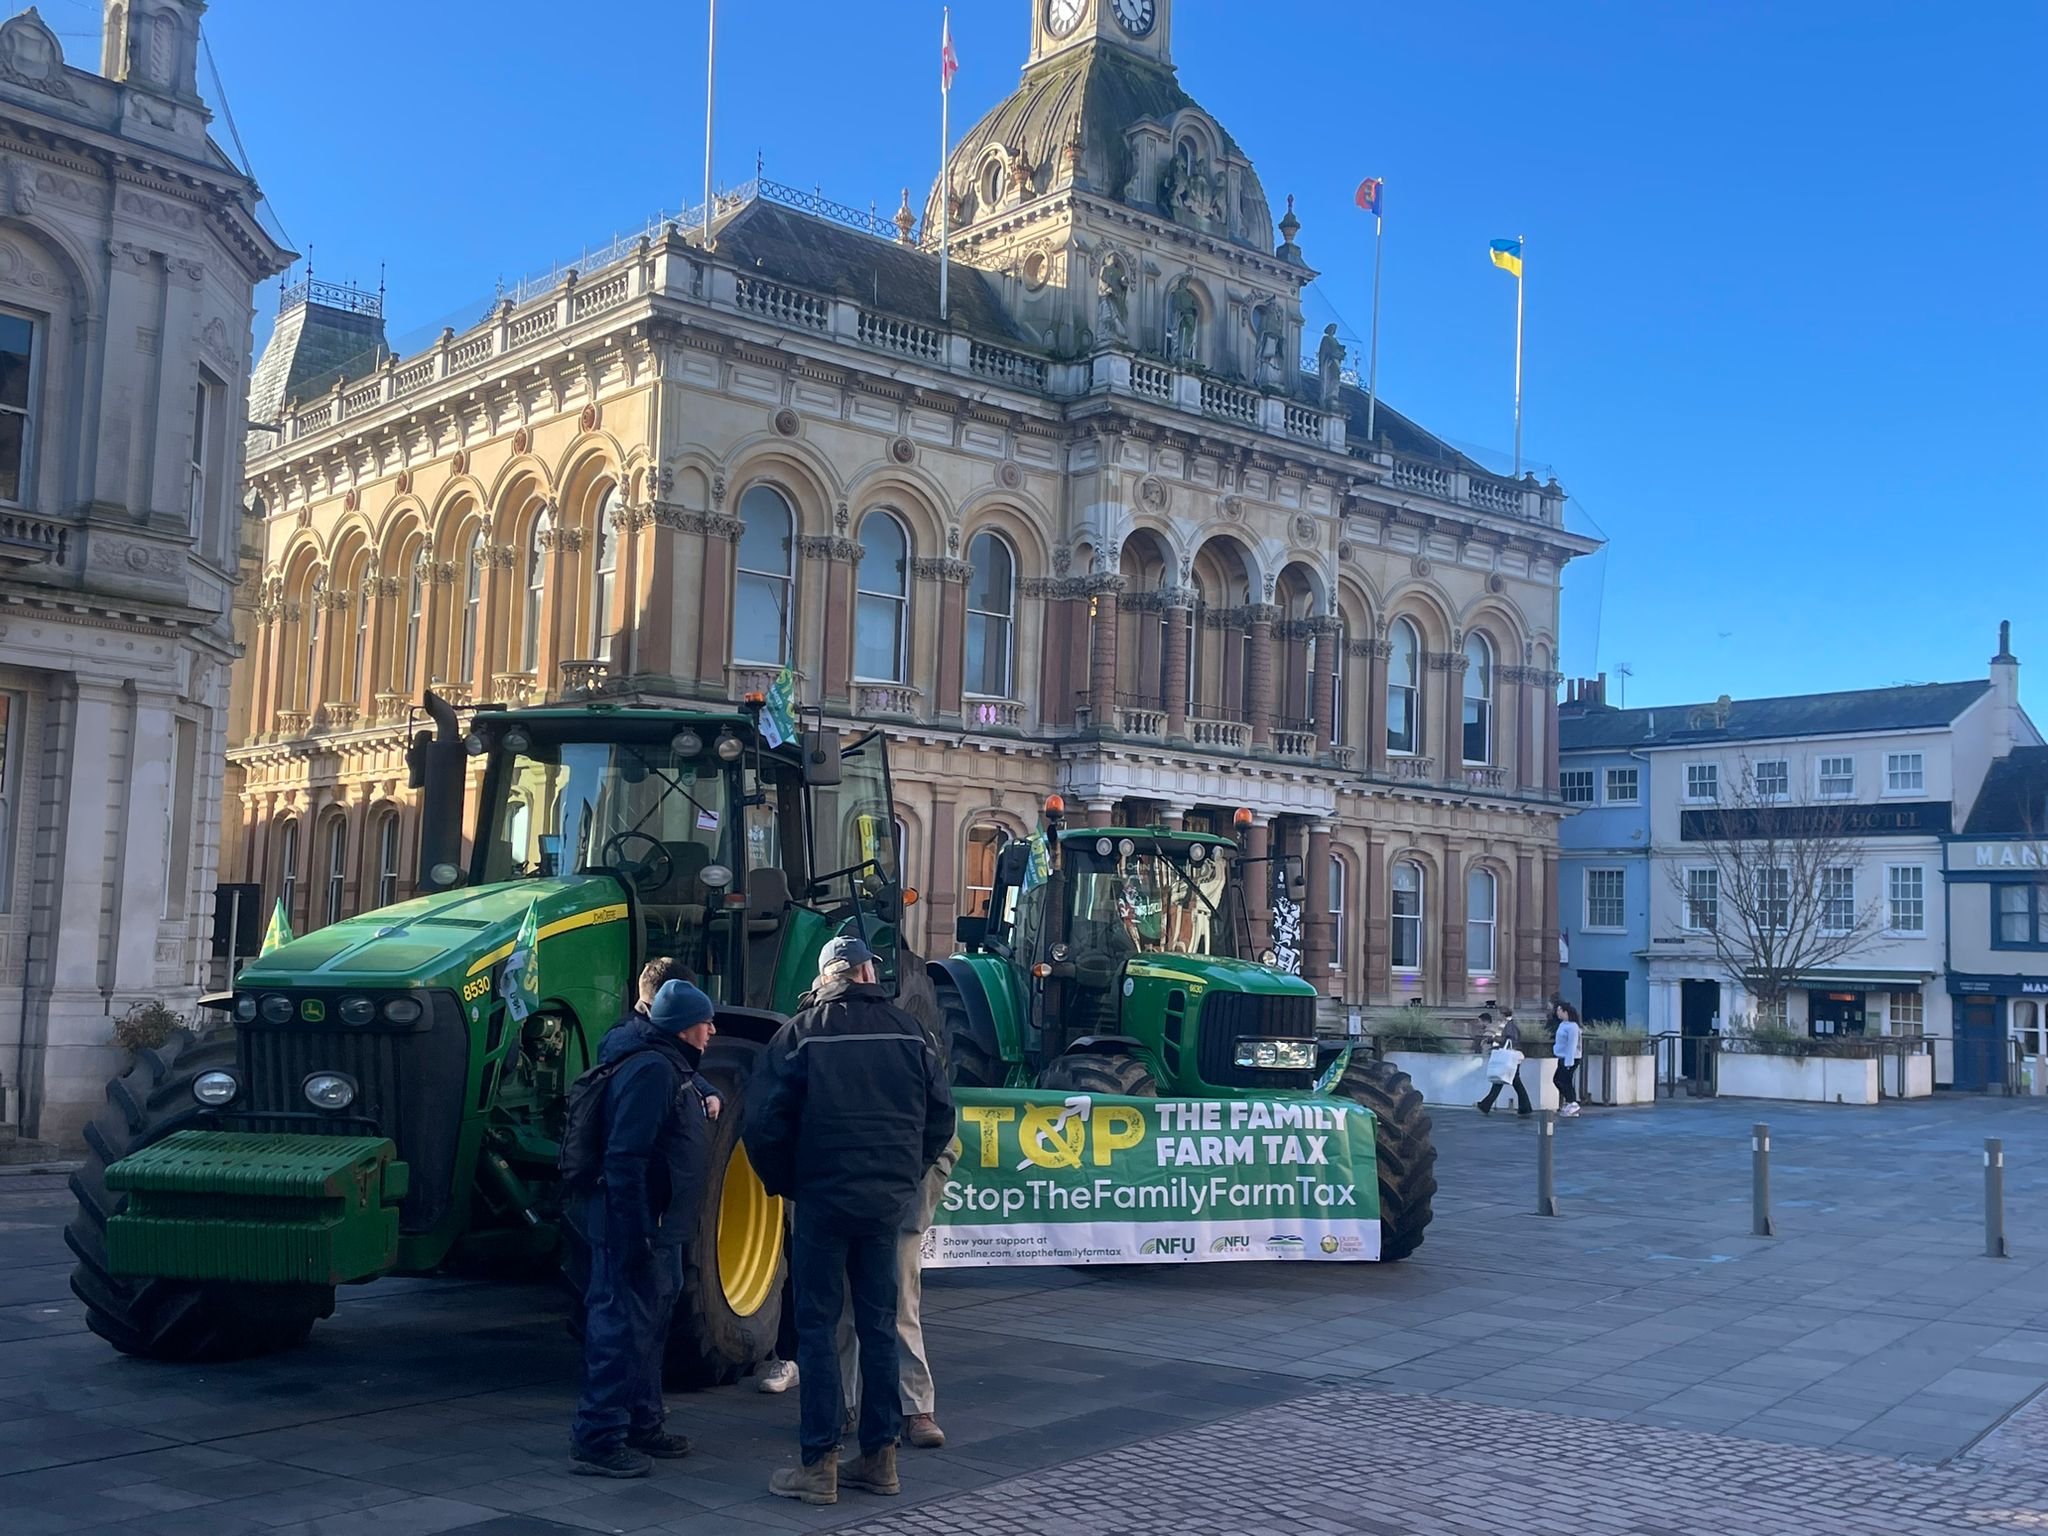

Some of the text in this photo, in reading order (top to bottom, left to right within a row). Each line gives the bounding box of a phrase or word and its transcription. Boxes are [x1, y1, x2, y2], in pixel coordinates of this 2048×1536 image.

[1850, 810, 1921, 829] HOTEL
[463, 976, 491, 1002] 8530
[1155, 1102, 1348, 1131] THE FAMILY
[955, 1102, 1145, 1169] TOP
[1156, 1135, 1329, 1166] FARM TAX
[943, 1236, 1048, 1246] Show your support at
[1155, 1237, 1195, 1254] NFU
[1224, 1236, 1250, 1247] NFU
